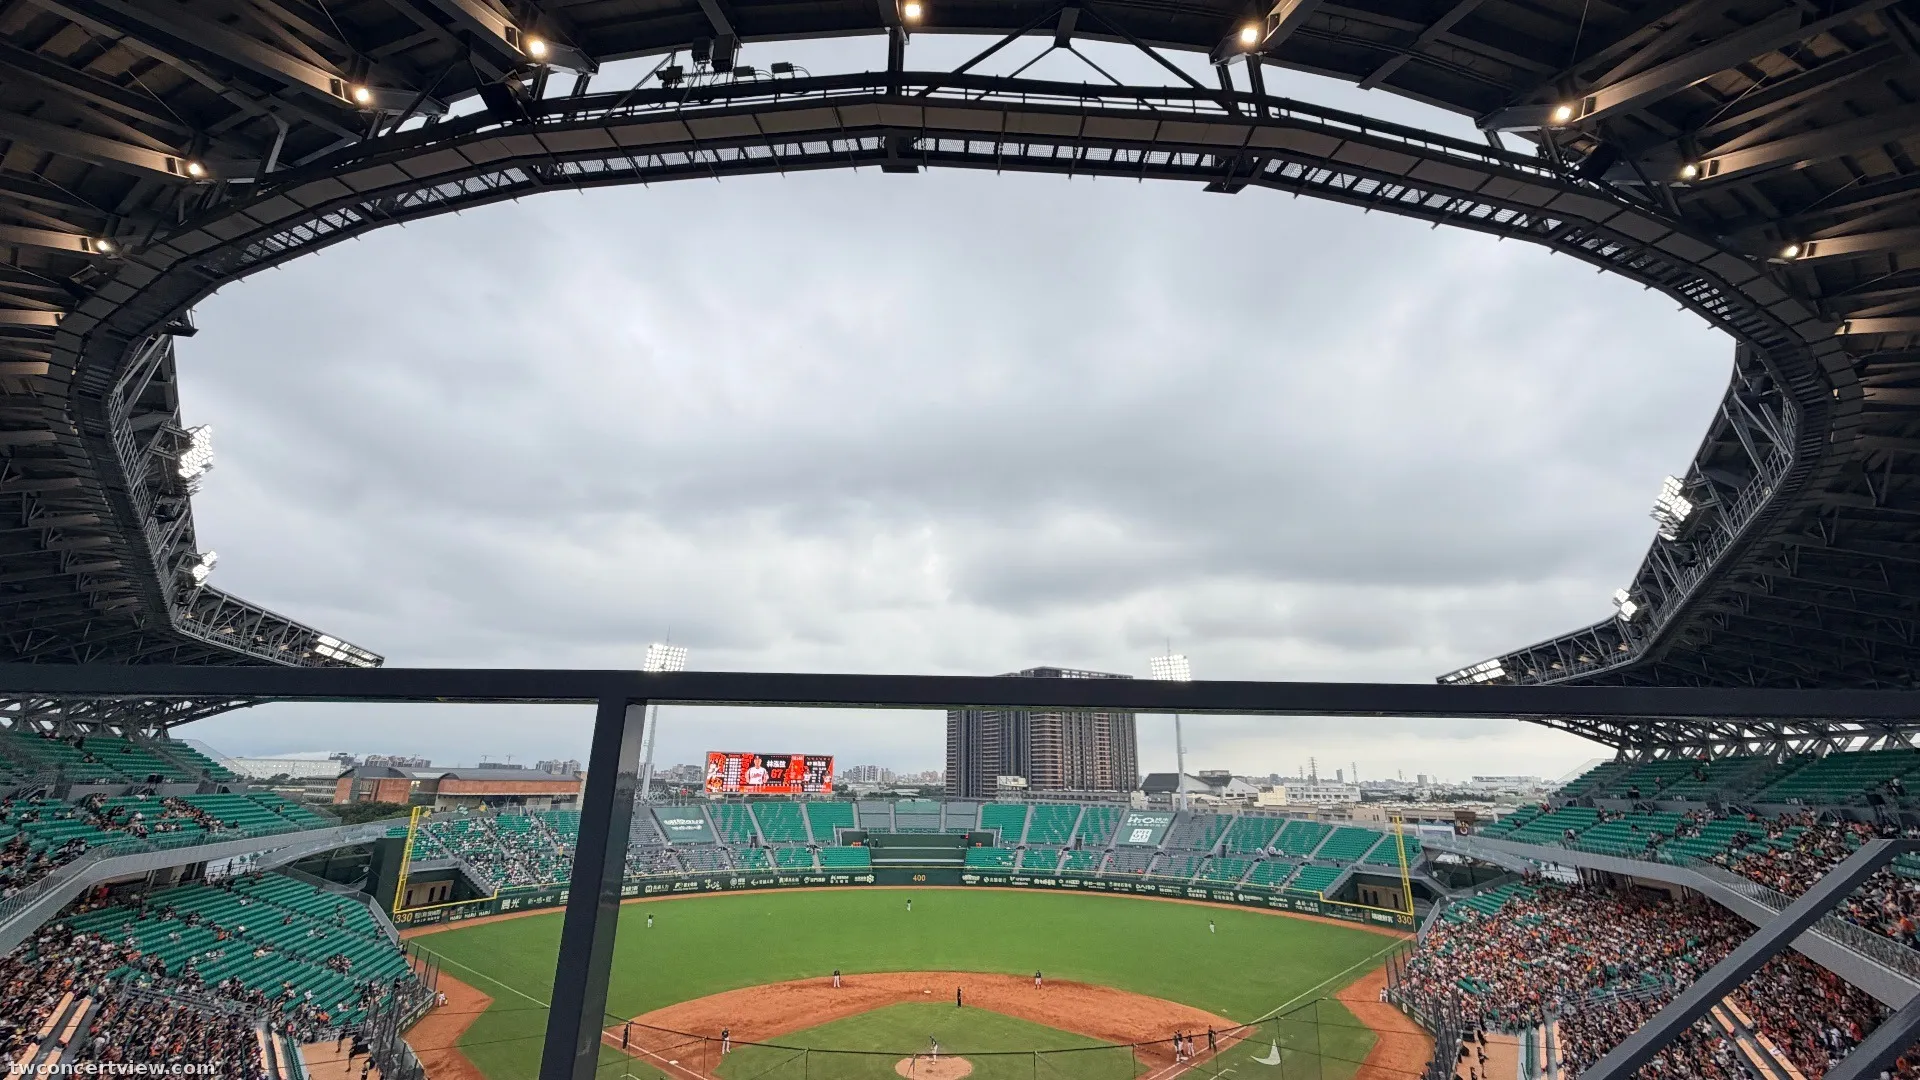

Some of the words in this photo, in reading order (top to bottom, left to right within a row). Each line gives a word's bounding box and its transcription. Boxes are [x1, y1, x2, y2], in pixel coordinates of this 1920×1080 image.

[771, 769, 783, 778] 67
[912, 874, 926, 882] 400
[395, 913, 413, 924] 330
[1396, 914, 1412, 925] 330
